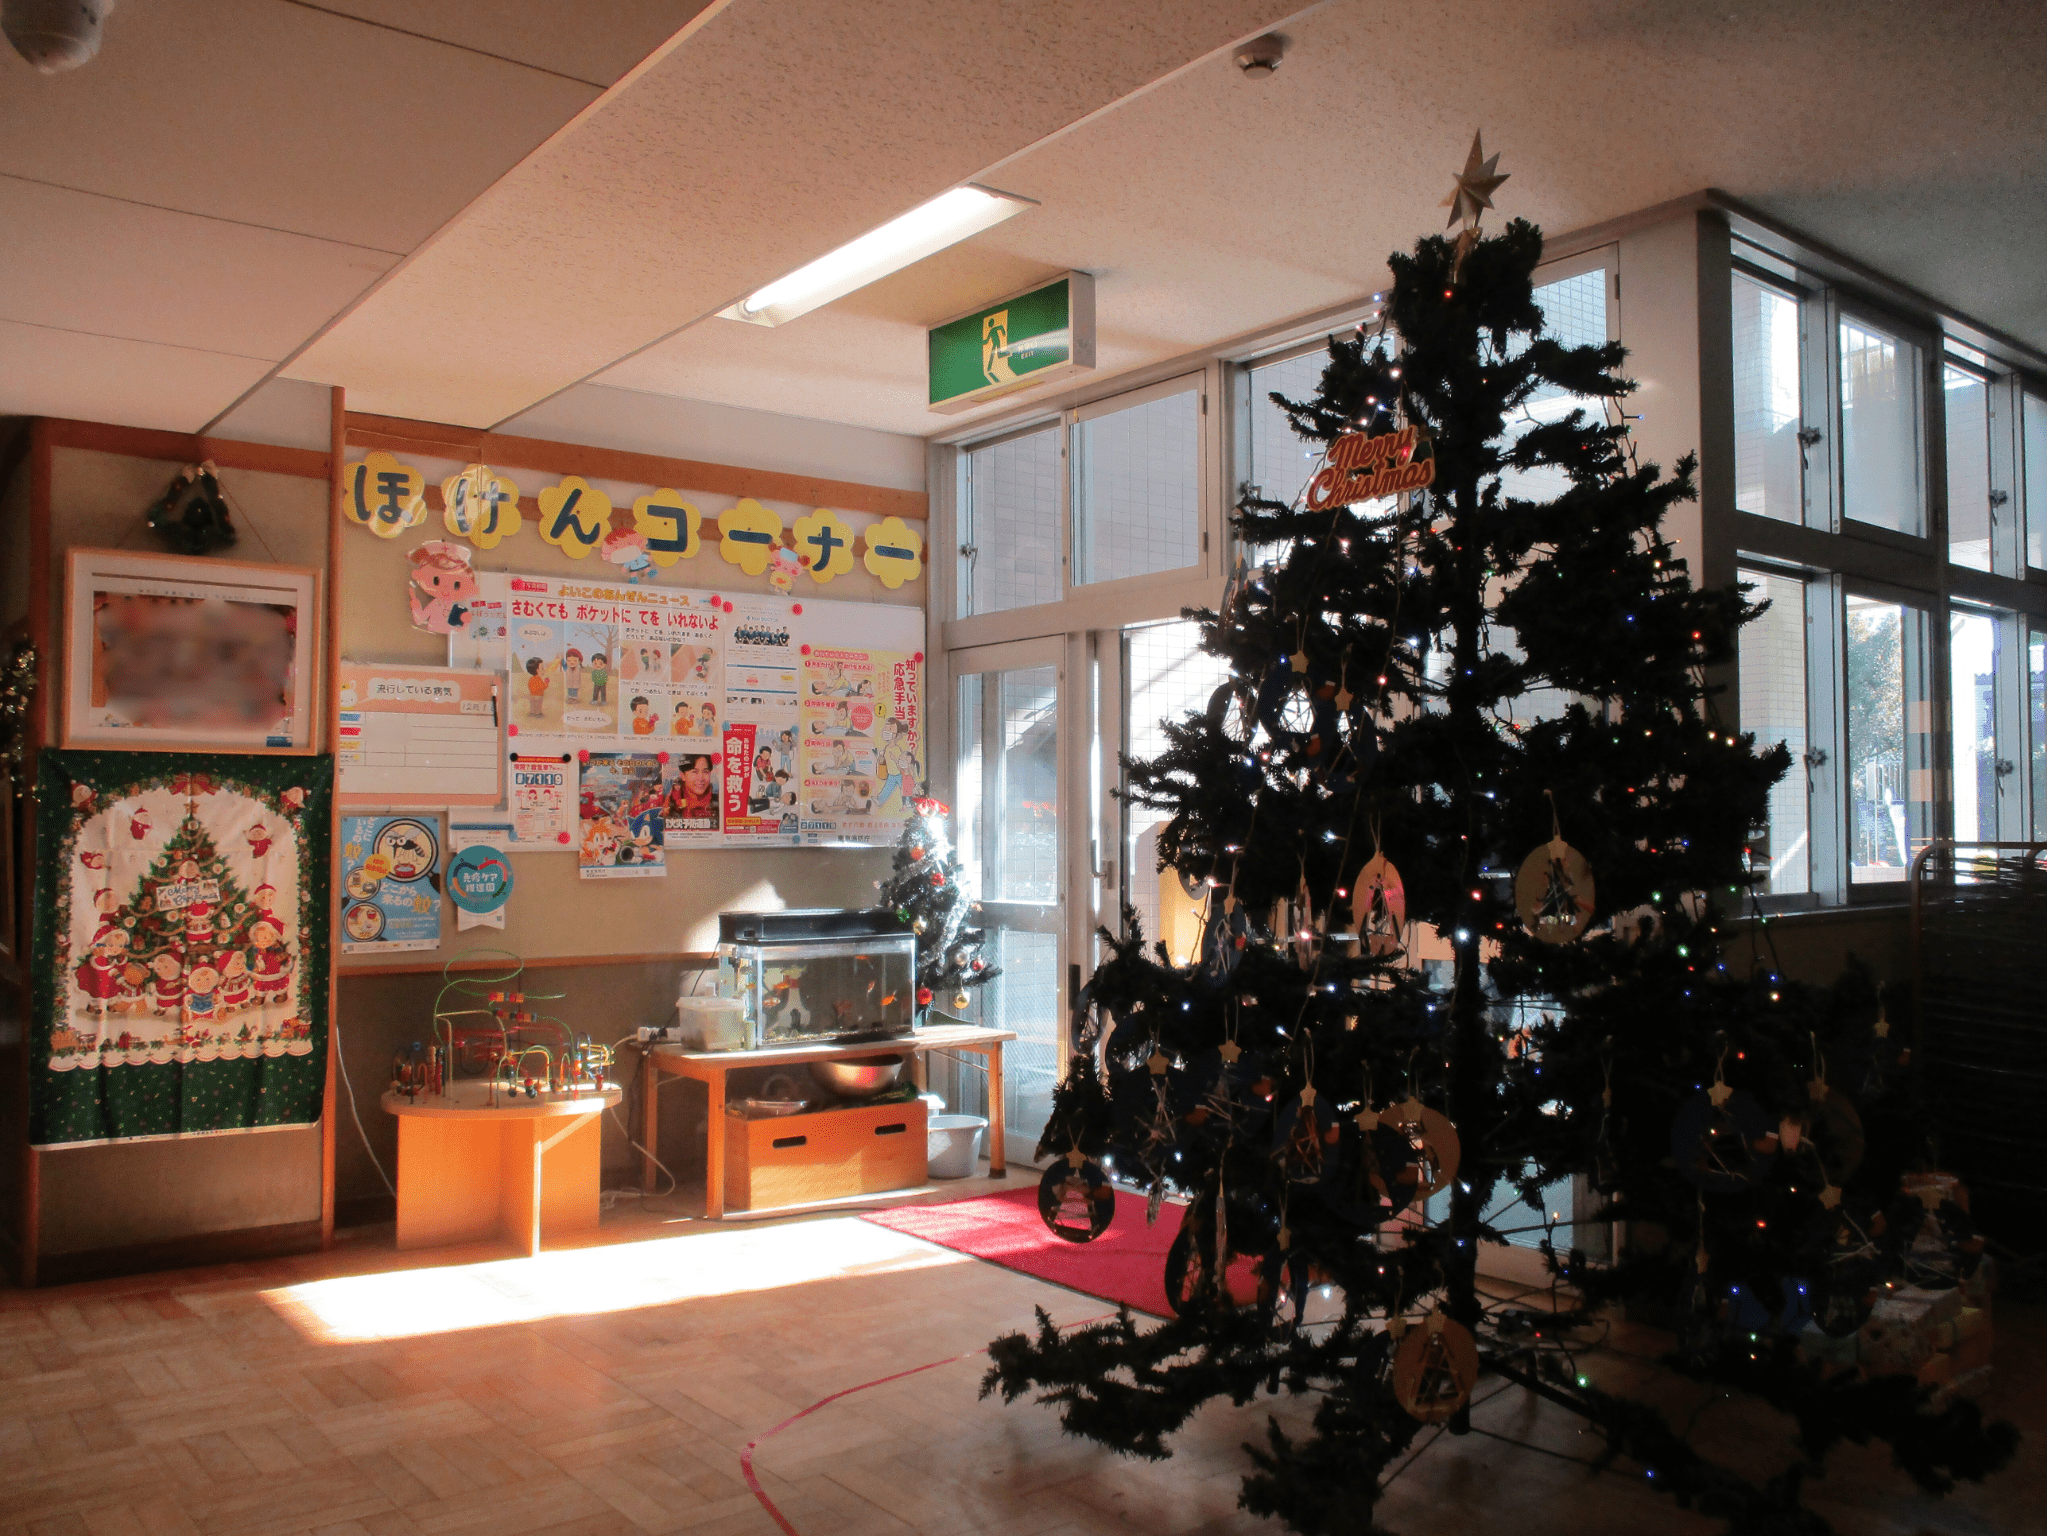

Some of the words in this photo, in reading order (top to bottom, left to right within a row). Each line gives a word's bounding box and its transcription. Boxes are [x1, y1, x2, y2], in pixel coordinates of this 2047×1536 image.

[1327, 425, 1417, 469] Merry
[1307, 458, 1435, 512] Christmas
[354, 465, 915, 571] ほけんコーナー
[512, 600, 569, 619] さむくても
[576, 604, 631, 624] ポケットに
[639, 611, 660, 626] てを
[667, 612, 719, 630] いれないよ
[558, 584, 690, 606] よいこのあんぜんニュース
[376, 684, 452, 697] 流行している病気
[893, 662, 905, 720] 応急手当
[905, 659, 919, 754] 知っていますか？
[725, 736, 743, 812] 命を救う
